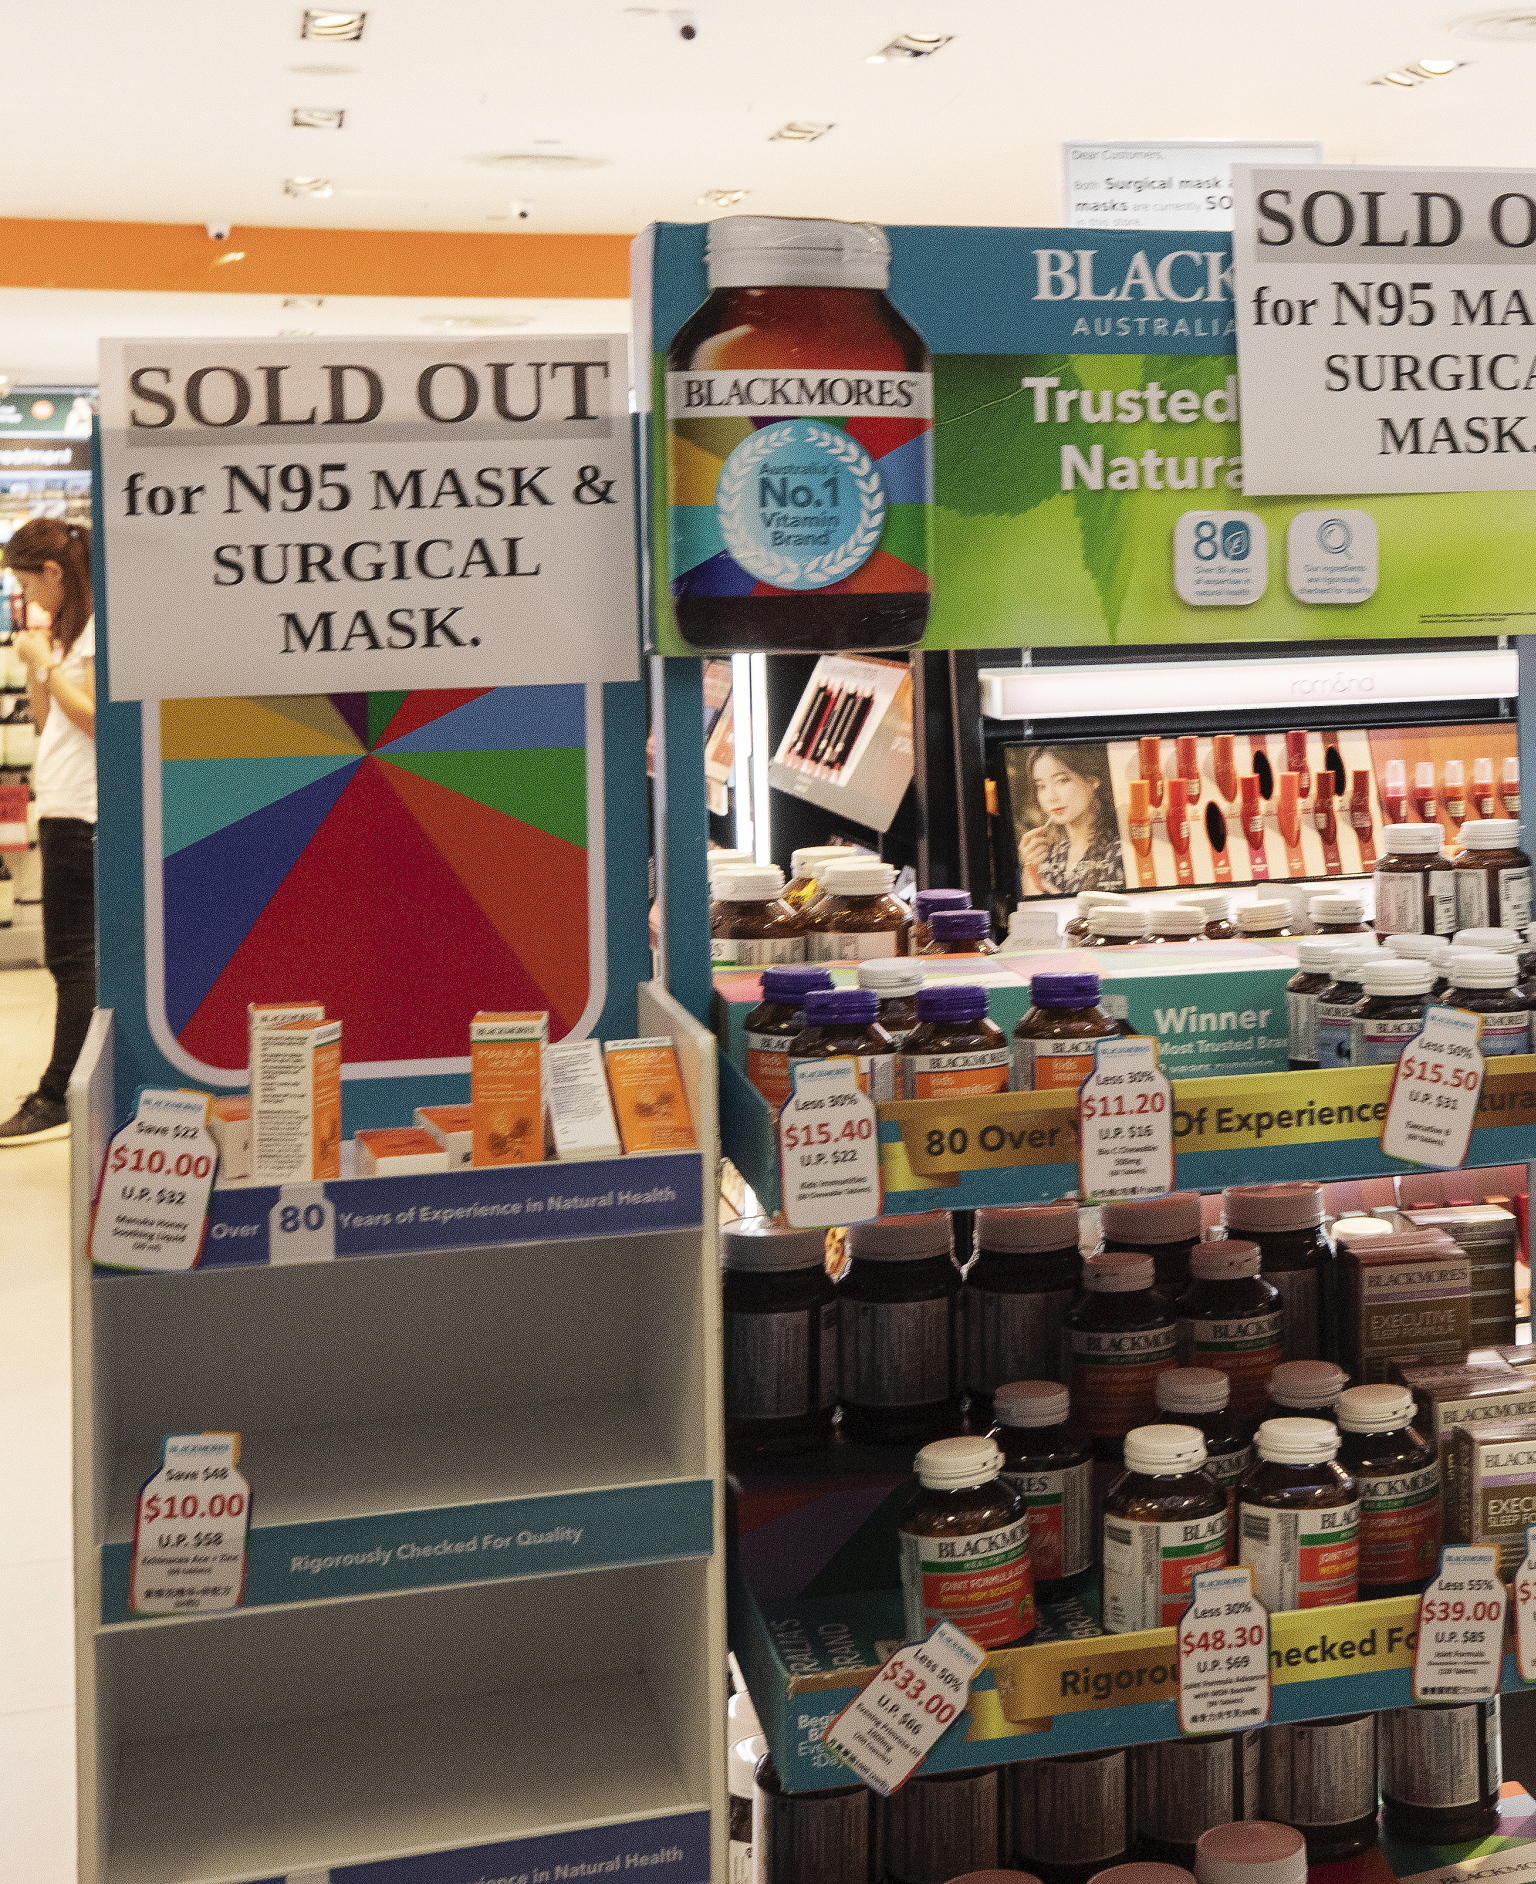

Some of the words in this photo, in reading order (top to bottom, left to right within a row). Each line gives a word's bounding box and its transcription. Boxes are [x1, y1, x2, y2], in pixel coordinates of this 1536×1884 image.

[1105, 176, 1173, 193] Surgical
[1178, 175, 1222, 190] mask
[1074, 199, 1129, 212] masks
[1256, 188, 1464, 250] SOLD
[1252, 285, 1318, 327] for
[1331, 281, 1436, 327] N95
[128, 363, 385, 430] SOLD
[416, 360, 611, 424] OUT
[684, 377, 916, 408] BLACKMORES
[1021, 374, 1239, 424] Trusted
[122, 471, 206, 517] for
[223, 462, 352, 515] N95
[370, 466, 551, 511] MASK
[572, 464, 619, 507] &
[758, 475, 842, 509] No.1
[760, 511, 841, 528] Vitamin
[771, 530, 830, 547] Brand
[213, 537, 541, 586] SURGICAL
[279, 605, 482, 655] MASK.
[1153, 1005, 1272, 1036] Winner
[1197, 1036, 1255, 1055] Trusted
[1400, 1054, 1480, 1092] $15.50
[1081, 1091, 1167, 1122] $11.20
[1408, 1088, 1433, 1106] U.P.
[136, 1120, 169, 1137] Save
[784, 1117, 873, 1153] $15.40
[924, 1126, 970, 1158] 80
[978, 1121, 1060, 1153] Over
[1172, 1105, 1208, 1138] Of
[1215, 1098, 1388, 1139] Experience
[1098, 1125, 1126, 1141] U.P.
[110, 1142, 212, 1180] $10.00
[799, 1153, 829, 1168] U.P.
[120, 1184, 152, 1203] U.P.
[210, 1222, 260, 1240] Over
[279, 1203, 326, 1233] 80
[337, 1210, 391, 1229] Years
[395, 1206, 417, 1225] of
[419, 1200, 522, 1224] Experience
[526, 1197, 544, 1212] in
[548, 1190, 615, 1213] Natural
[617, 1186, 678, 1204] Health
[1368, 1267, 1468, 1289] BLACKMORES
[1371, 1308, 1457, 1331] EXECUTIVE
[165, 1467, 199, 1482] Save
[144, 1492, 245, 1525] $10.00
[1487, 1512, 1520, 1529] SLEEP
[158, 1533, 189, 1549] U.P.
[290, 1546, 391, 1574] Rigorously
[396, 1535, 478, 1560] Checked
[481, 1530, 511, 1551] For
[515, 1525, 584, 1548] Quality
[1437, 1579, 1466, 1592] Less
[1466, 1578, 1495, 1592] 55%
[1193, 1605, 1223, 1621] Less
[1422, 1598, 1502, 1626] $39.00
[1181, 1624, 1265, 1659] $48.30
[1434, 1630, 1459, 1645] U.P.
[912, 1647, 938, 1673] Less
[936, 1667, 965, 1694] 50%
[1196, 1658, 1223, 1675] U.P.
[876, 1693, 901, 1719] U.P.
[881, 1659, 956, 1725] $33.00
[554, 1854, 621, 1881] Natural
[624, 1844, 684, 1869] Health
